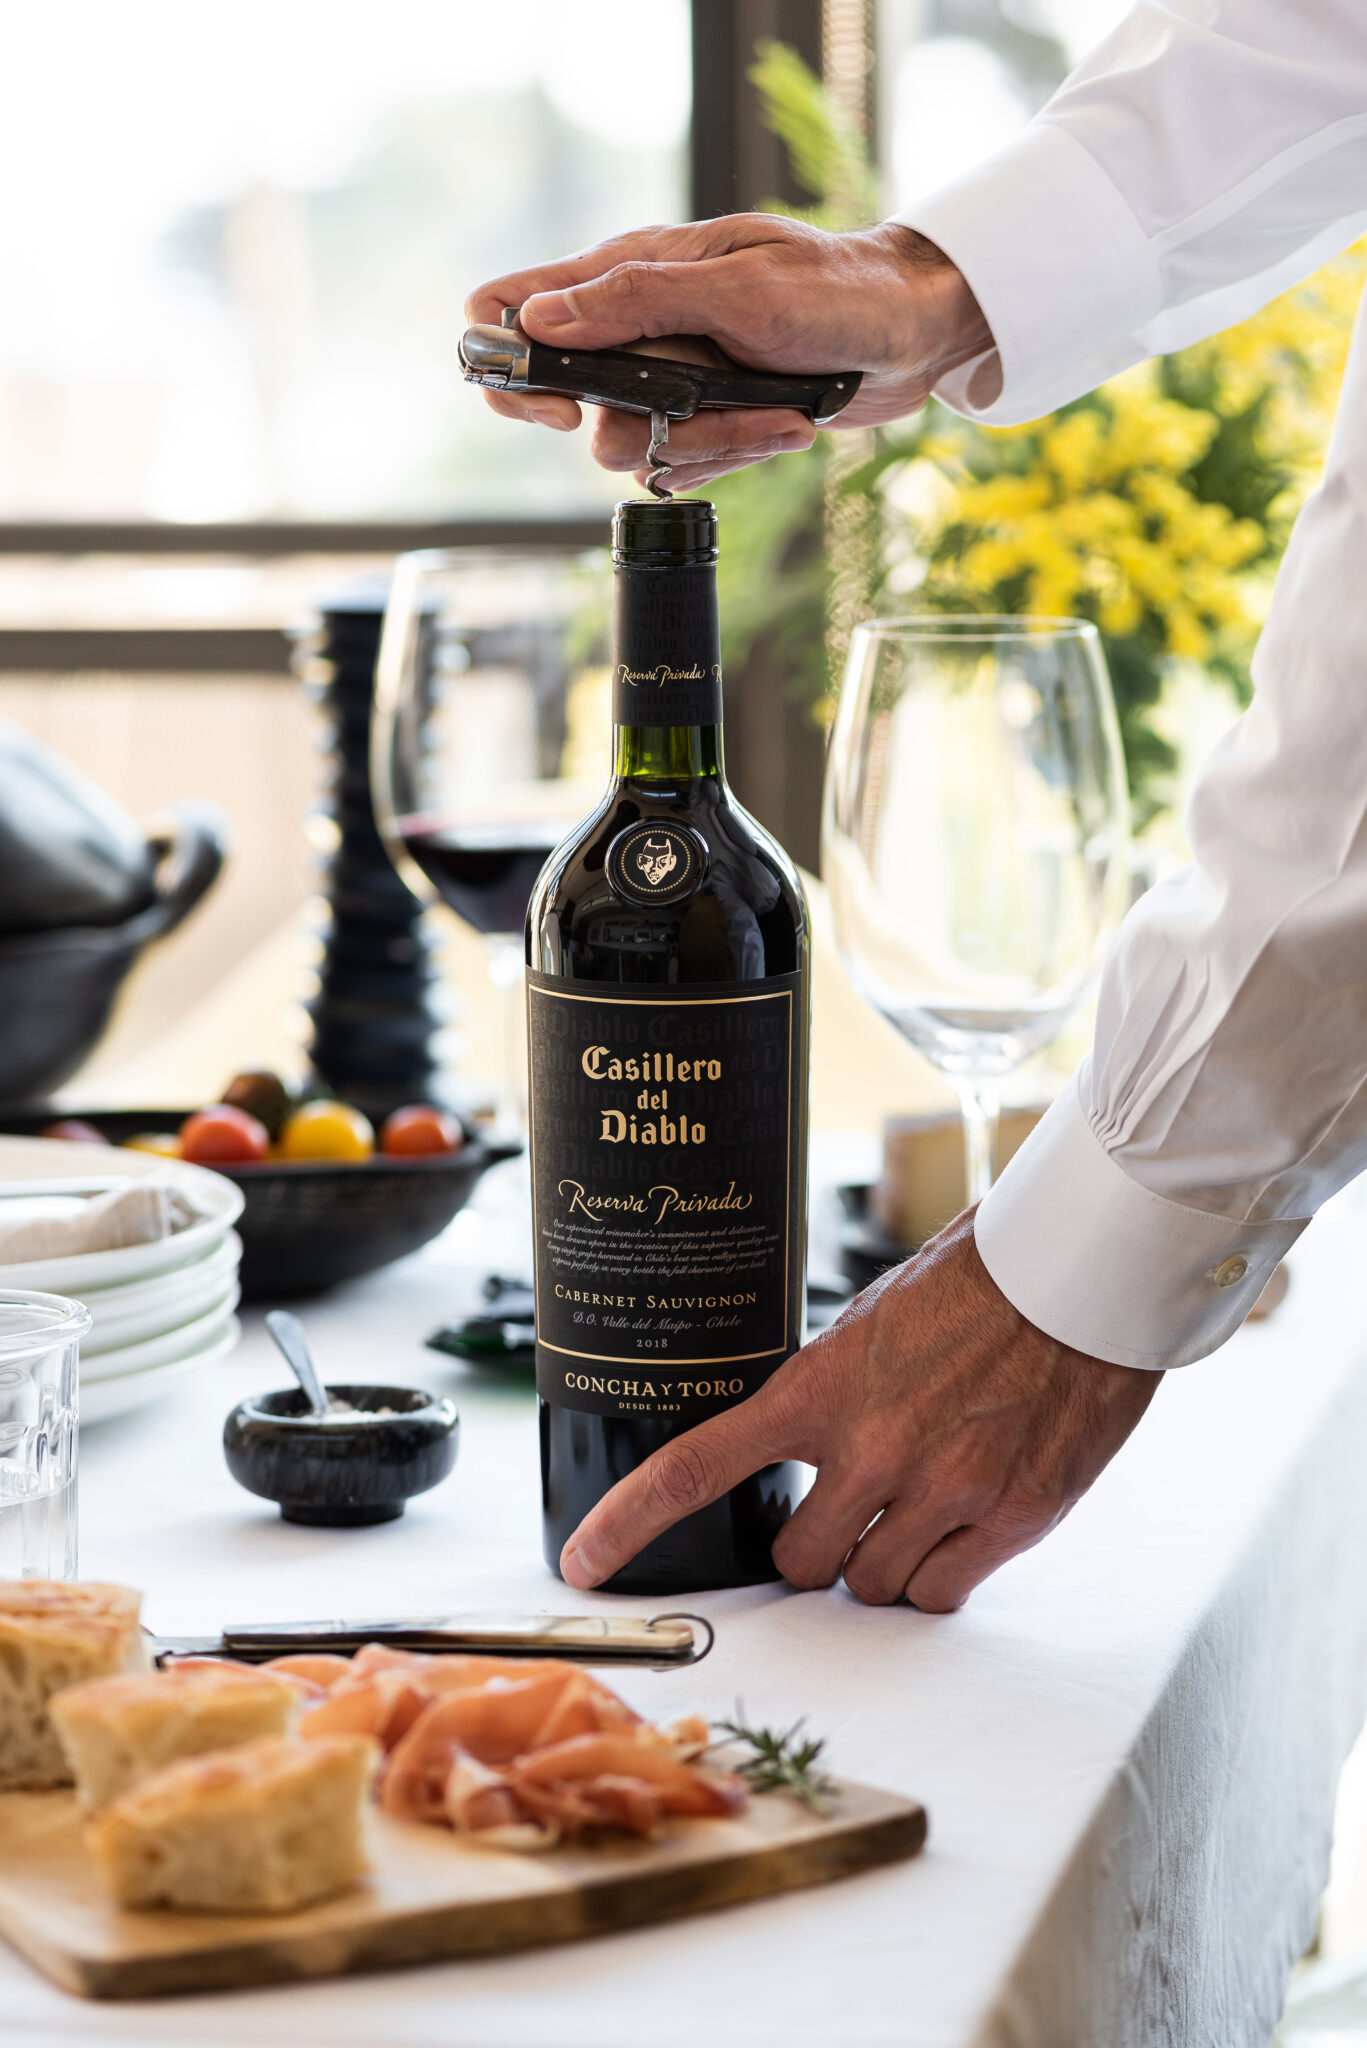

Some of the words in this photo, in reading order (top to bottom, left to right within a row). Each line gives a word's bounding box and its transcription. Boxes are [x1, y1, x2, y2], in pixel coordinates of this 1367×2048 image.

[618, 664, 658, 687] Reserva
[655, 664, 706, 688] Privada
[581, 1045, 721, 1082] Casillero
[637, 1089, 668, 1110] del
[599, 1109, 706, 1145] Diablo
[558, 1179, 648, 1222] Reserva
[647, 1180, 753, 1225] Privada
[553, 1218, 564, 1228] Our
[565, 1223, 604, 1236] experienced
[605, 1228, 655, 1239] winemaker's
[657, 1230, 709, 1239] commitment
[710, 1226, 726, 1237] and
[728, 1225, 766, 1236] dedication
[553, 1231, 565, 1242] been
[566, 1233, 586, 1245] drawn
[588, 1238, 607, 1249] upon
[608, 1239, 619, 1249] in
[619, 1239, 633, 1250] the
[634, 1242, 670, 1251] creation
[670, 1241, 682, 1254] of
[682, 1241, 699, 1251] this
[701, 1240, 735, 1253] superior
[736, 1234, 763, 1250] quality
[561, 1246, 577, 1258] single
[577, 1250, 597, 1262] grape
[597, 1250, 633, 1262] harvested
[634, 1253, 643, 1262] in
[645, 1252, 671, 1263] Chile's
[673, 1252, 690, 1263] best
[691, 1253, 710, 1262] wine
[711, 1250, 738, 1263] valleys
[570, 1259, 600, 1273] perfectly
[601, 1263, 610, 1272] in
[610, 1266, 631, 1277] every
[633, 1265, 656, 1275] bottle
[657, 1265, 670, 1275] the
[665, 1264, 688, 1278] full
[688, 1264, 725, 1275] character
[725, 1261, 737, 1275] of
[736, 1263, 749, 1271] our
[573, 1311, 598, 1326] D.O.
[601, 1314, 630, 1330] Valle
[631, 1316, 650, 1330] del
[653, 1317, 693, 1335] Maipo
[706, 1313, 743, 1330] Chile
[636, 1338, 669, 1350] 2018
[564, 1371, 658, 1399] CONCHA
[660, 1383, 673, 1397] Y
[677, 1378, 745, 1398] TORO
[618, 1402, 652, 1411] DESDE
[656, 1403, 682, 1412] 1883
